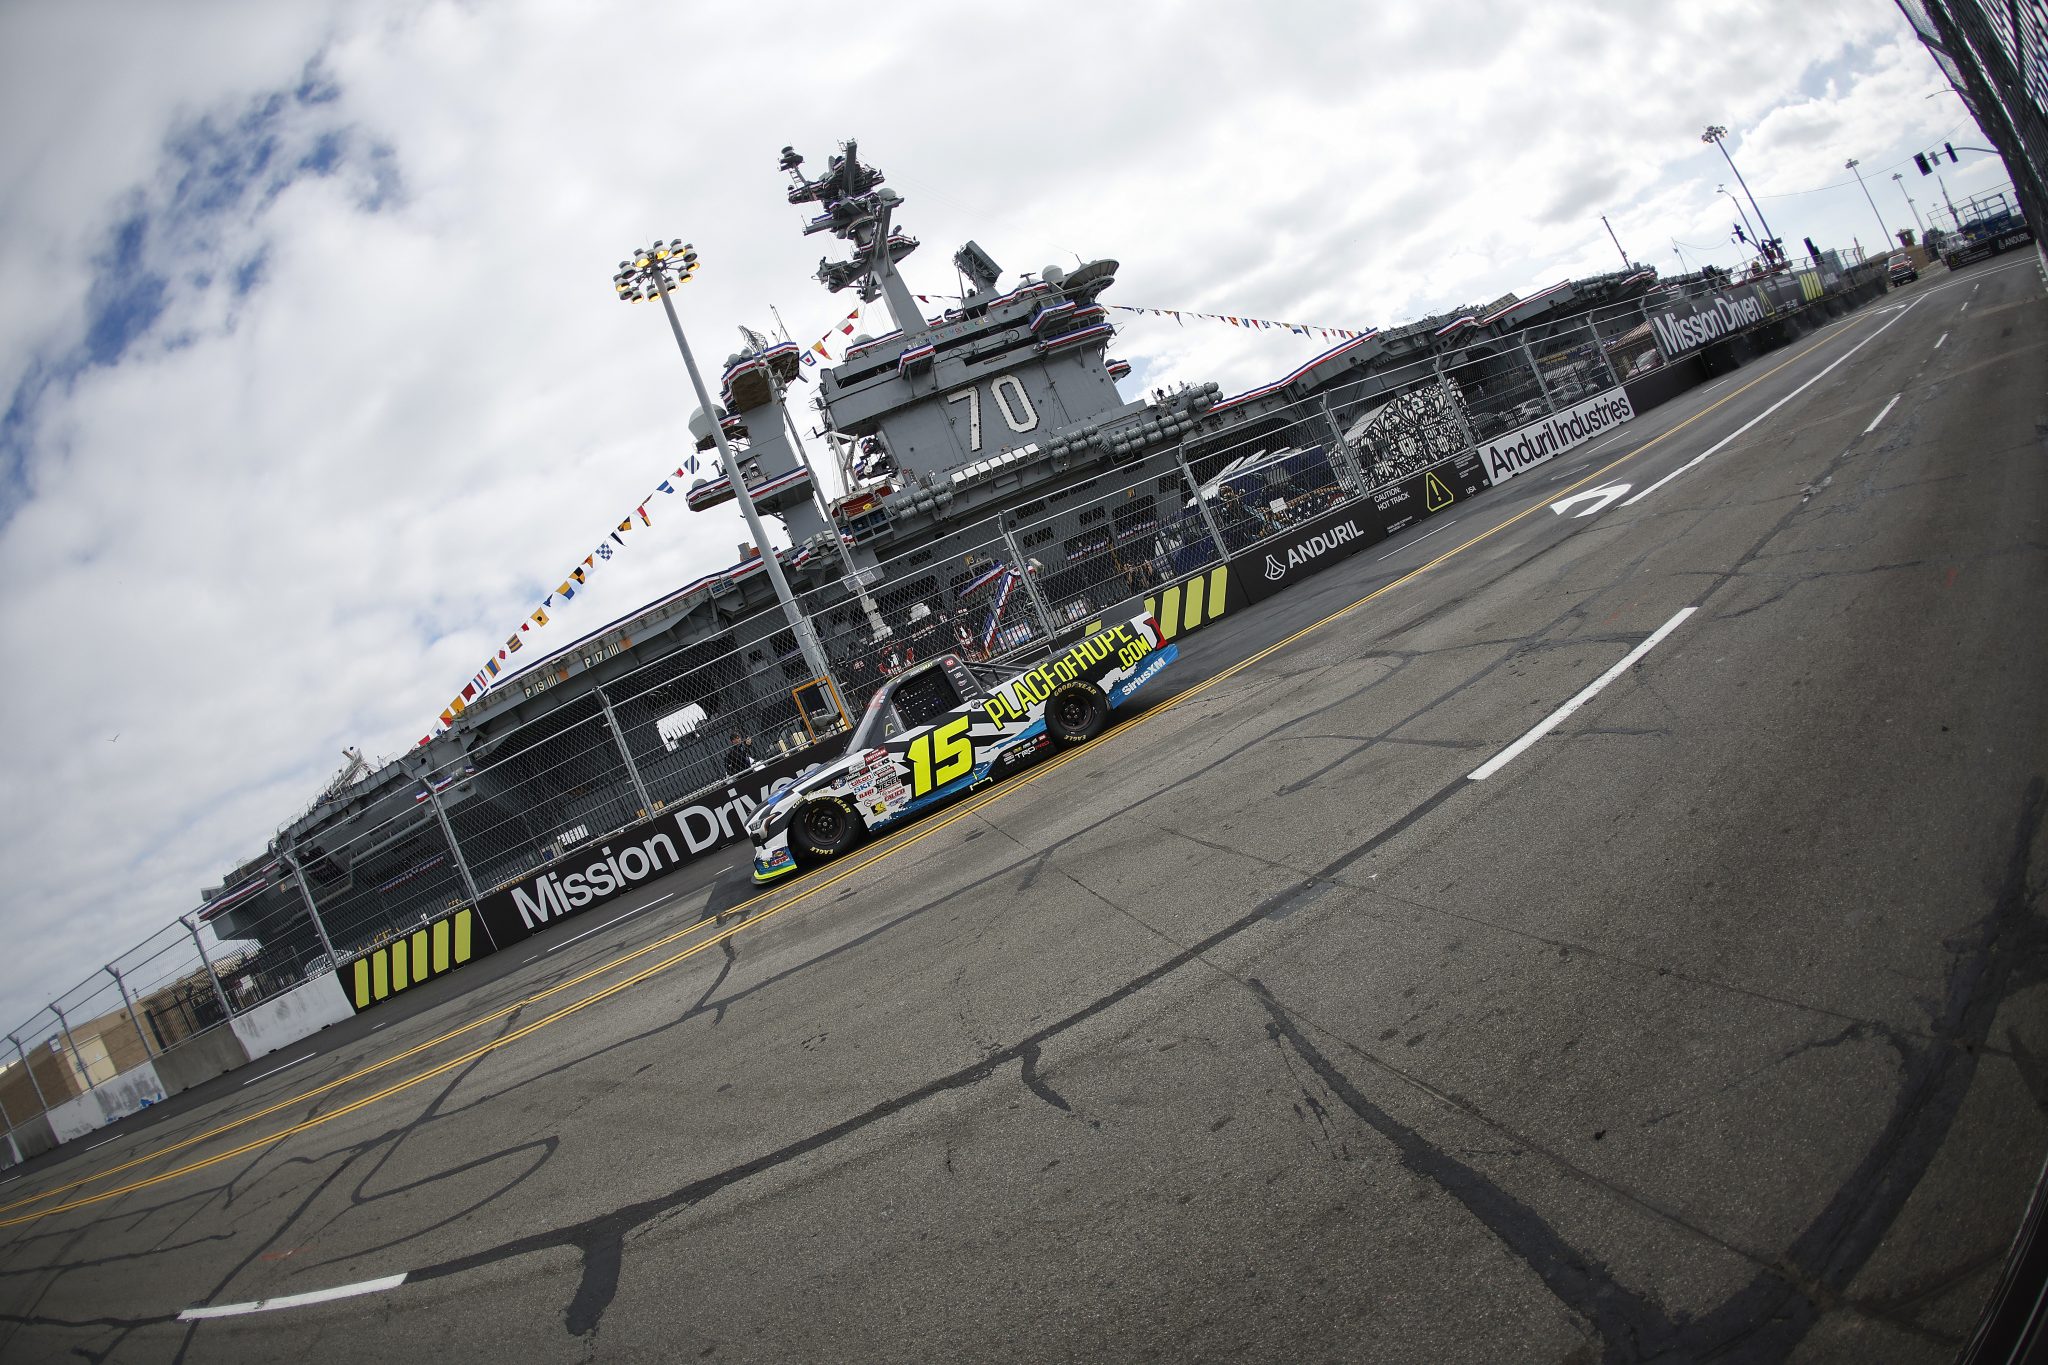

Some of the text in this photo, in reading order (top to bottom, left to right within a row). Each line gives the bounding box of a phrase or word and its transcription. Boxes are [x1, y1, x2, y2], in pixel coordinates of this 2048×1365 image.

[1653, 294, 1763, 355] Mission Driven
[946, 374, 1040, 452] 70
[1489, 397, 1630, 478] Anduril Industries
[1373, 486, 1402, 503] CAUTION:
[1377, 491, 1411, 511] HOT TRACK
[1465, 485, 1477, 495] USA
[1287, 519, 1365, 569] ANDURIL
[583, 657, 591, 669] P
[1121, 657, 1166, 696] SiriusXM
[524, 688, 531, 698] P
[534, 681, 545, 693] 19
[907, 714, 972, 797] 15
[854, 780, 873, 793] SKF
[878, 776, 899, 791] JESEL
[511, 763, 822, 930] Mission Driv
